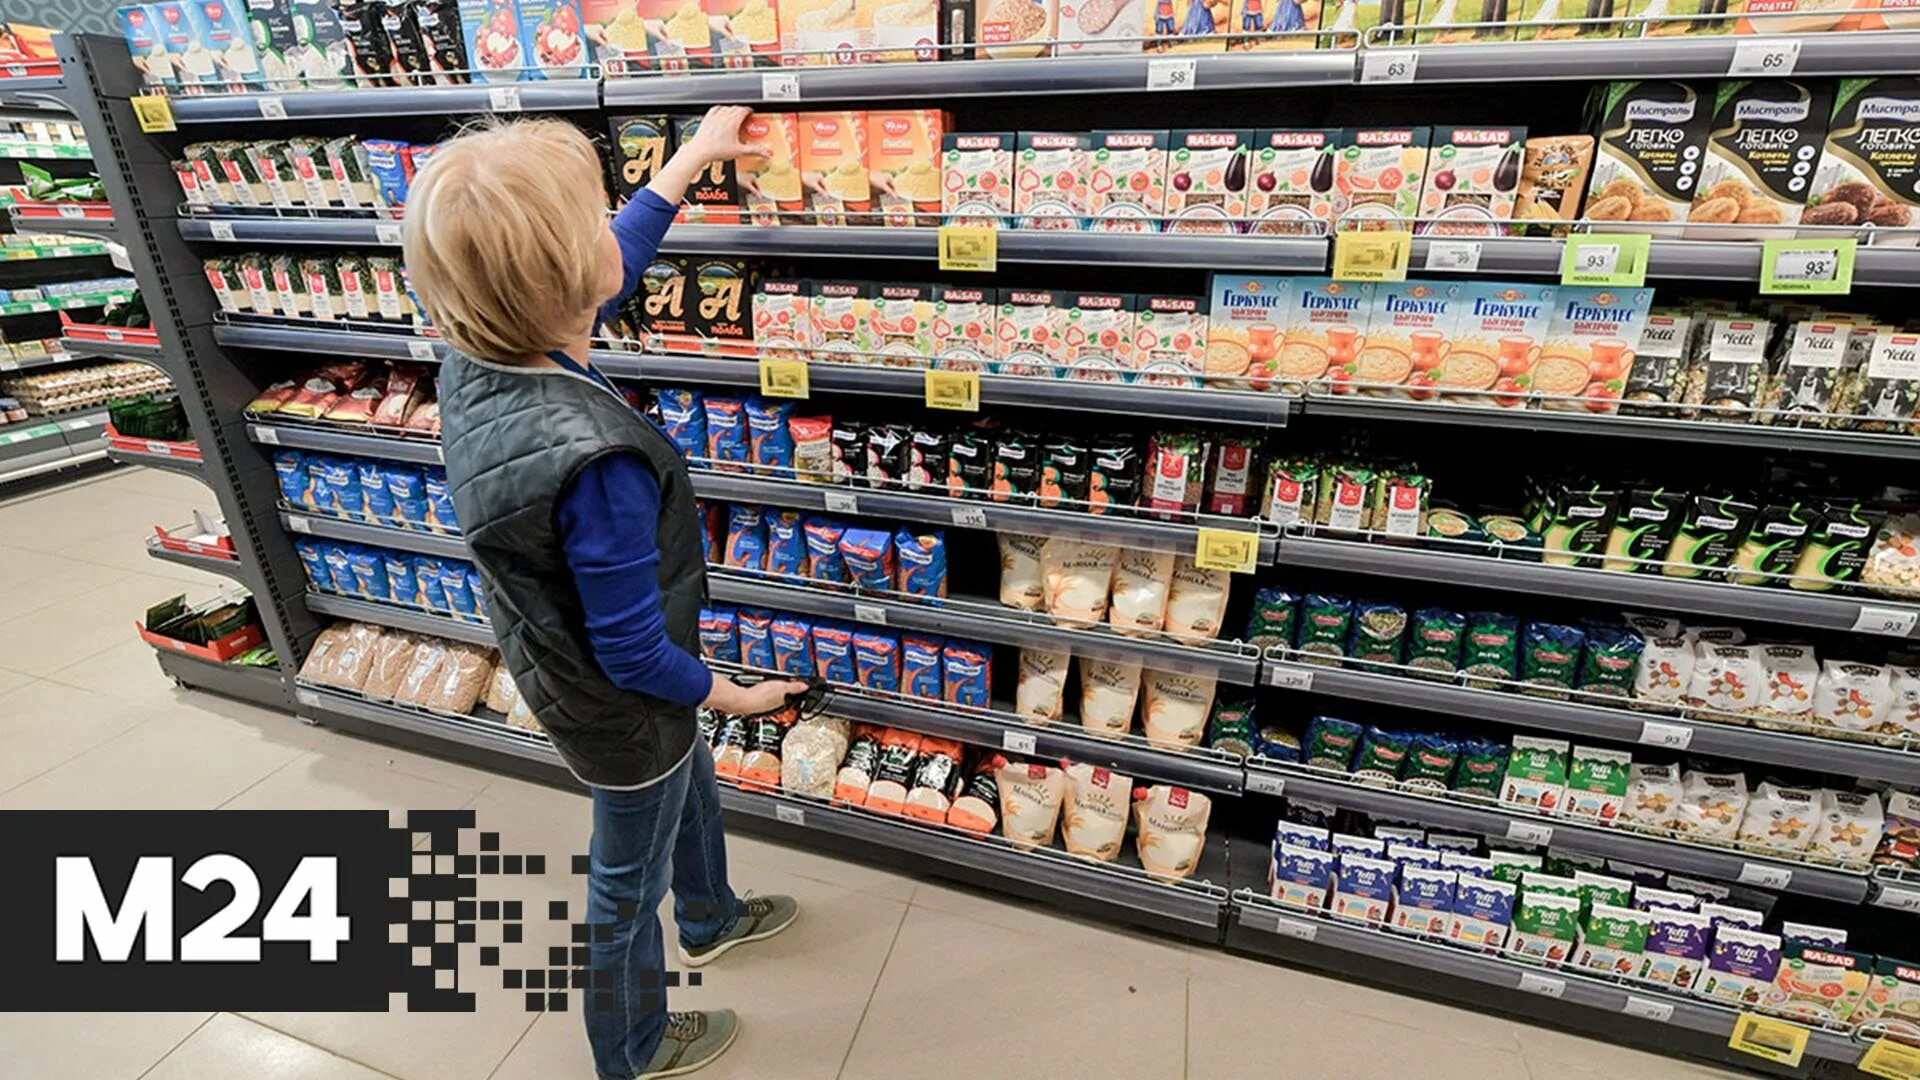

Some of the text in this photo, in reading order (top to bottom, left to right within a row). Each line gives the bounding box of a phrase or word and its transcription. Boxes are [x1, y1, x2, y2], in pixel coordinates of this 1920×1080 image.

[1762, 54, 1784, 68] 65
[1388, 64, 1405, 76] 63
[1170, 71, 1185, 83] 58
[780, 84, 792, 94] 41
[1629, 105, 1690, 118] Мистраль
[1738, 104, 1806, 118] Мистраль
[1625, 128, 1685, 144] ЛЕГКО
[1735, 128, 1799, 144] ЛЕГКО
[1587, 255, 1605, 268] 93
[1804, 261, 1825, 275] 93
[1884, 622, 1902, 632] 93
[1665, 735, 1680, 744] 93
